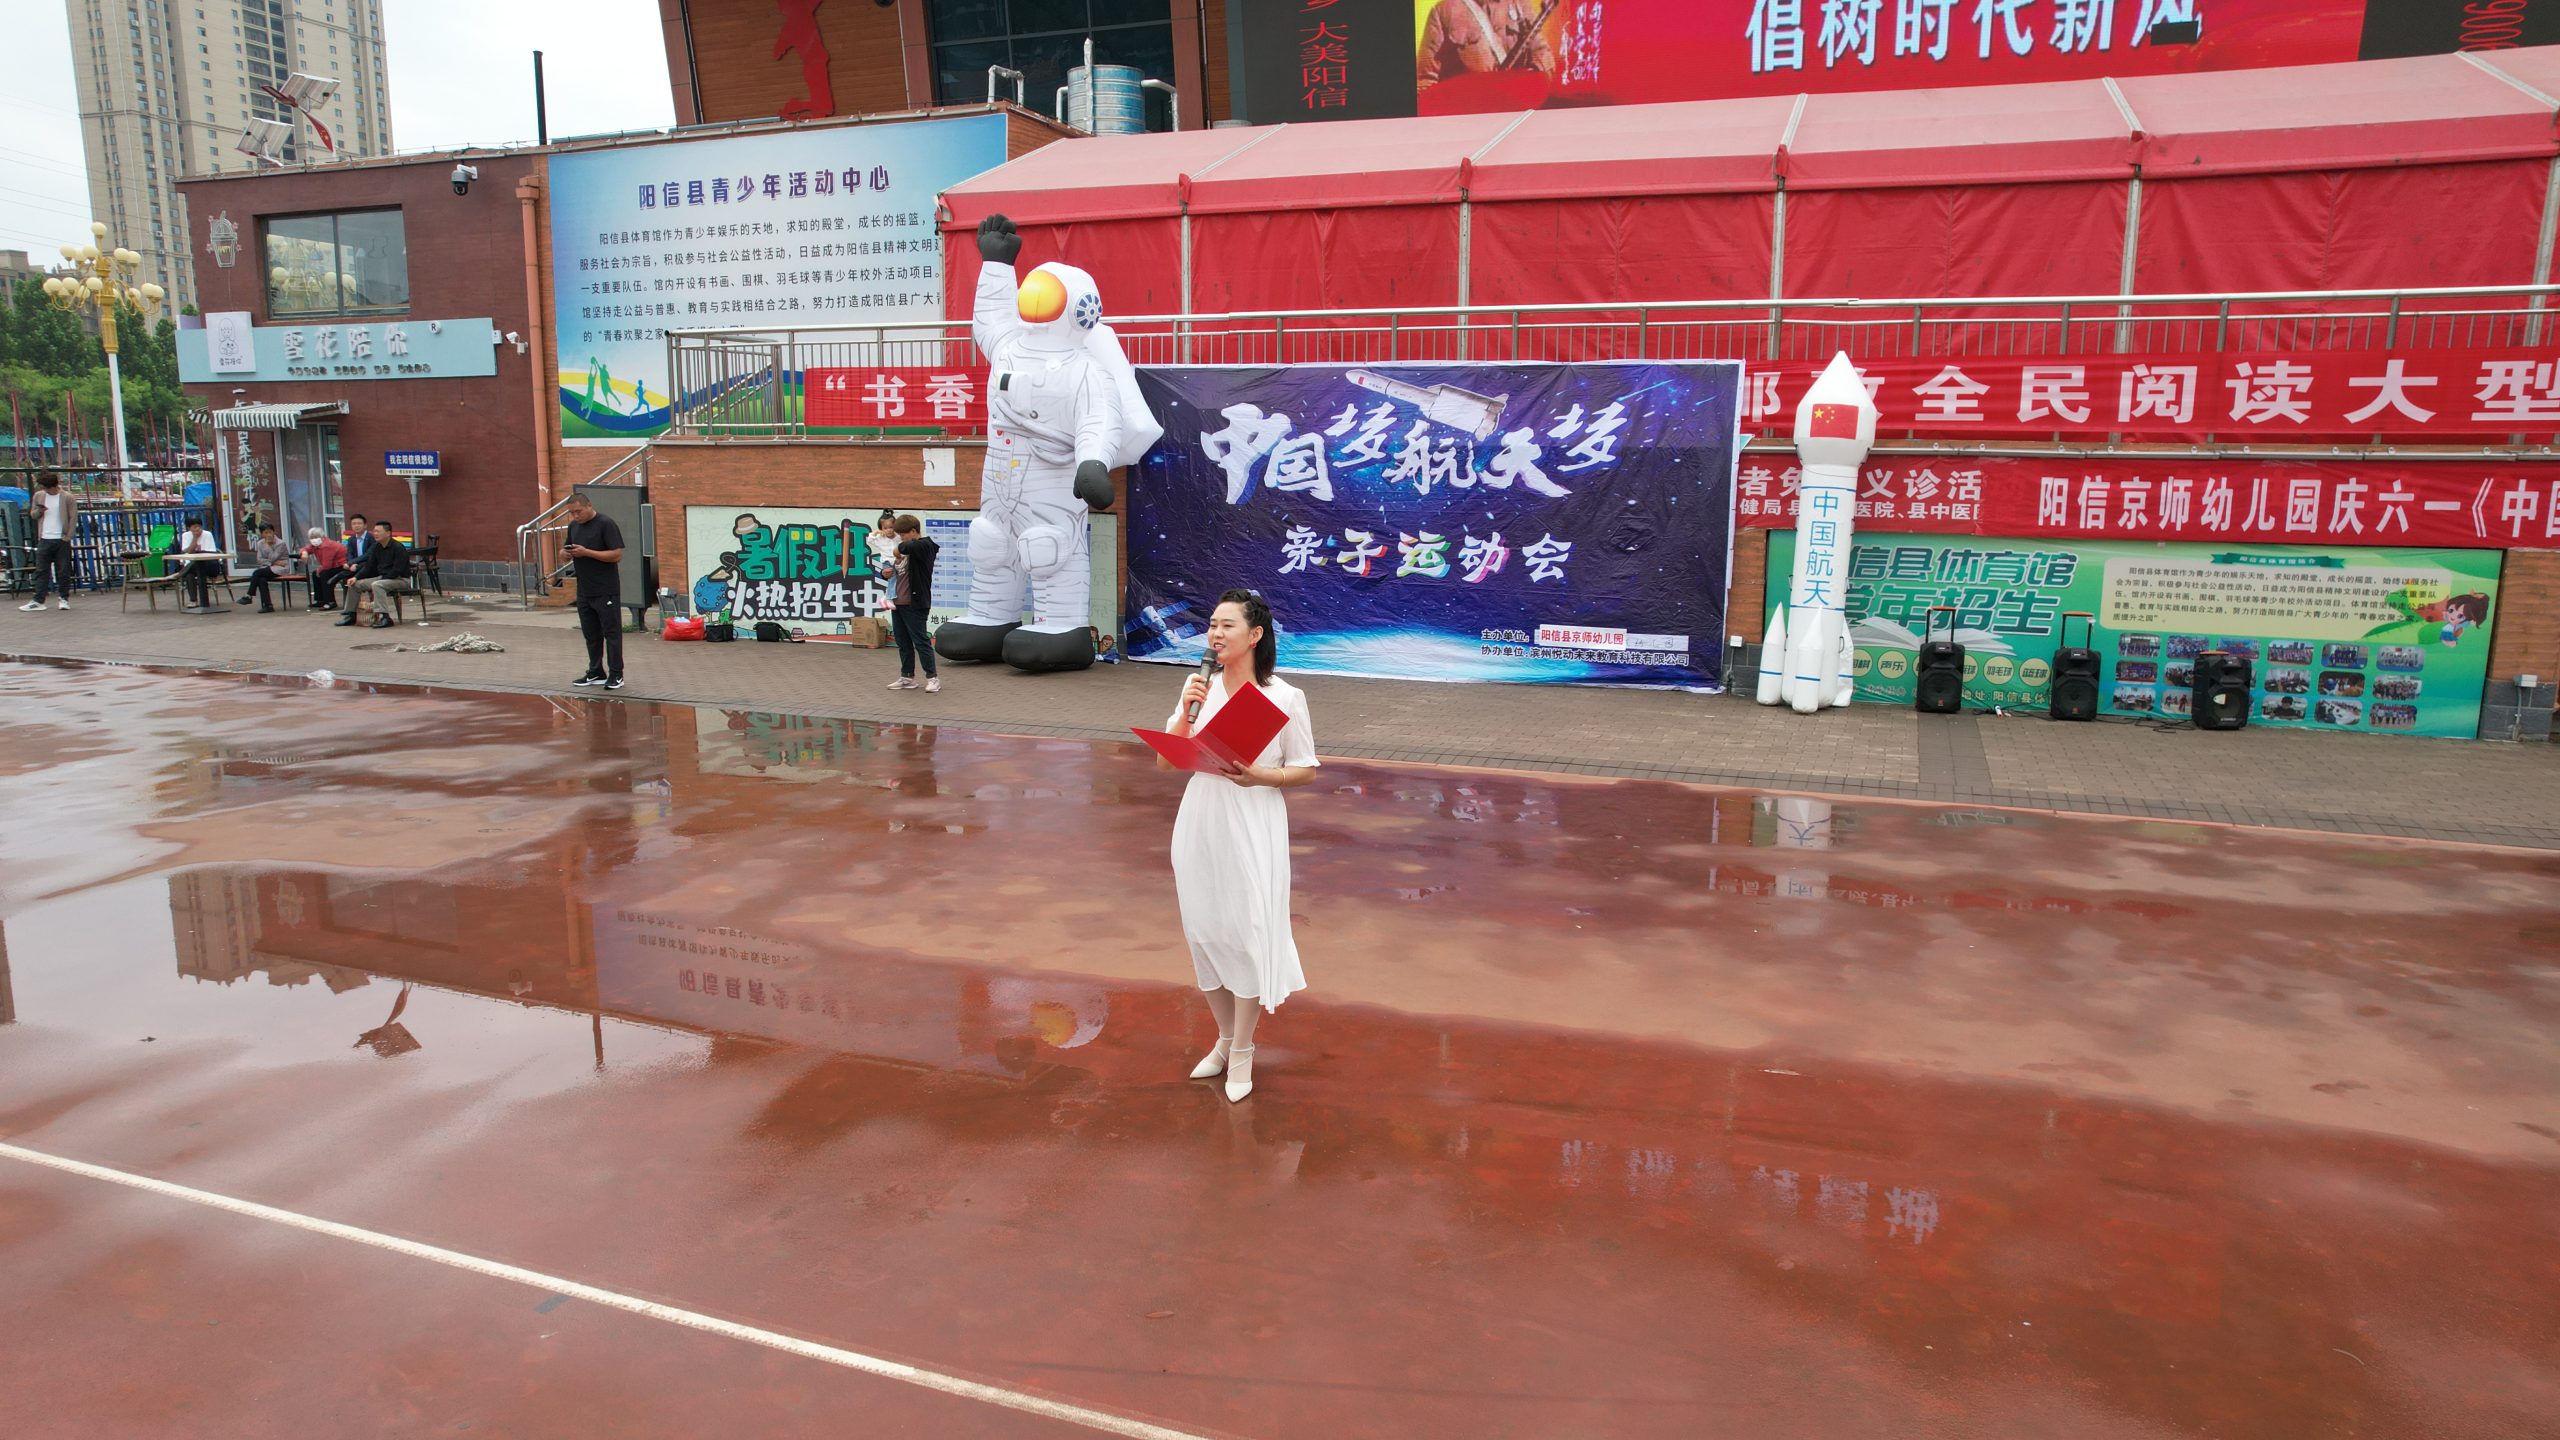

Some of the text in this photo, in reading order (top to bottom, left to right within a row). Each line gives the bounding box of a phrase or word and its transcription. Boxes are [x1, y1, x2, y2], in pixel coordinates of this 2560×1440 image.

[1300, 21, 1351, 109] 大美阳信
[638, 165, 890, 210] 阳信县青少年活动中心
[599, 212, 938, 246] 阳信县体育馆作为青少年娱乐的天地，求知的殿堂，成长的摇篮，
[736, 524, 873, 580] 暑假班
[1277, 525, 1572, 583] 亲子运动会
[1803, 490, 1839, 606] 中国航天
[727, 580, 887, 619] 火热招生中
[1541, 629, 1624, 645] 阳信县京师幼儿园
[1986, 665, 2011, 677] 羽毛球
[2022, 668, 2048, 679] 篮球
